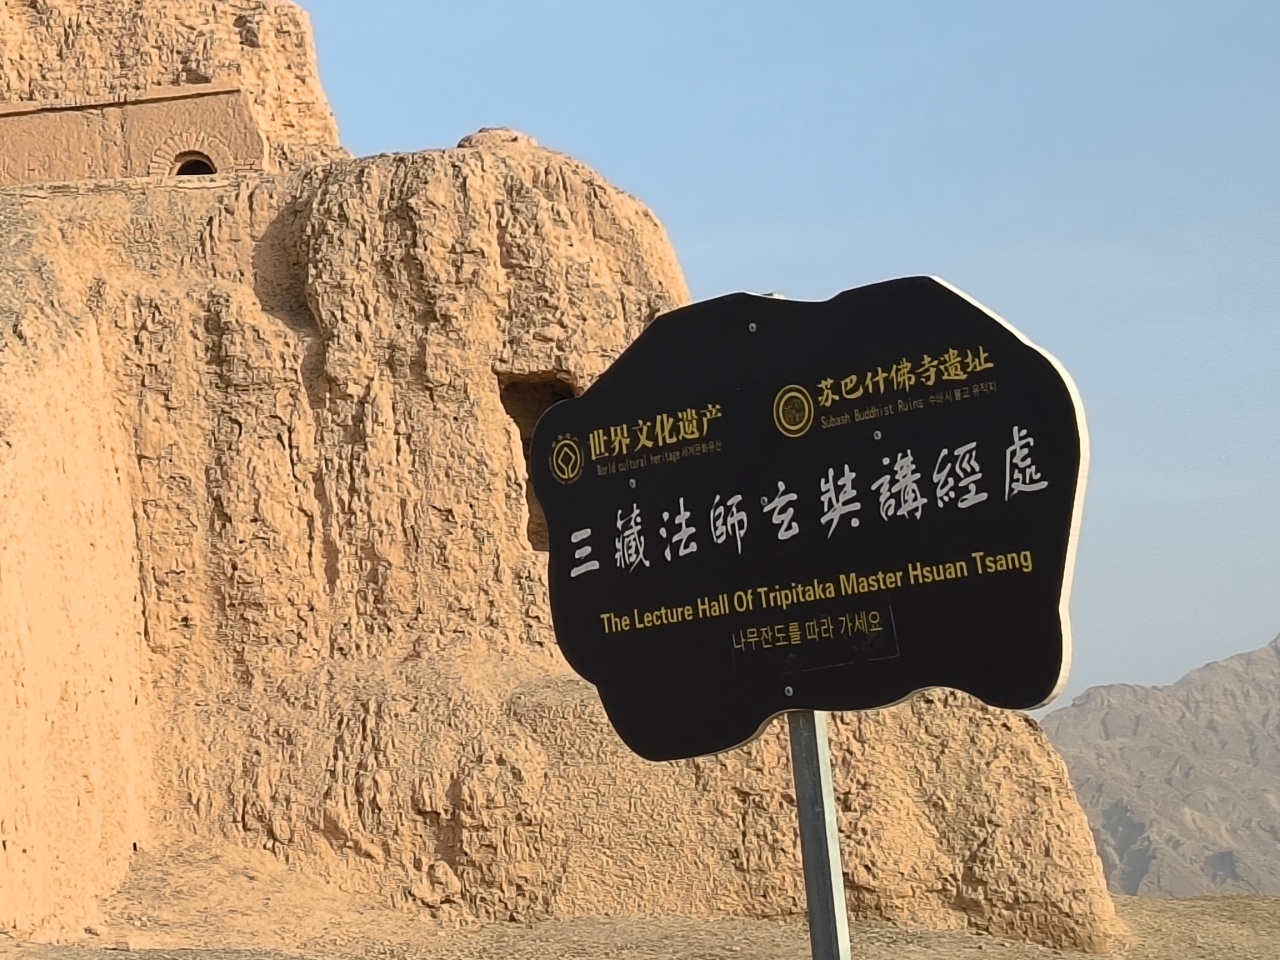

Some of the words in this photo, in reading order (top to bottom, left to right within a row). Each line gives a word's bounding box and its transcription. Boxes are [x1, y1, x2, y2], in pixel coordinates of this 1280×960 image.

[816, 345, 995, 408] 苏巴什佛寺遗址
[588, 403, 722, 460] 世界文化遗产
[821, 412, 851, 429] Subash
[854, 403, 894, 422] Buddhist
[897, 397, 924, 413] Ruins
[600, 611, 630, 634] The
[634, 604, 694, 629] Lecture
[697, 593, 729, 618] Hall
[733, 589, 754, 612] Of
[757, 579, 835, 610] Tripitaka
[839, 572, 903, 596] Master
[908, 561, 968, 584] Hsuan
[971, 550, 1033, 574] Tsang
[732, 621, 802, 652] 나무잔도를
[805, 616, 834, 642] 따라
[838, 610, 883, 637] 가세요
